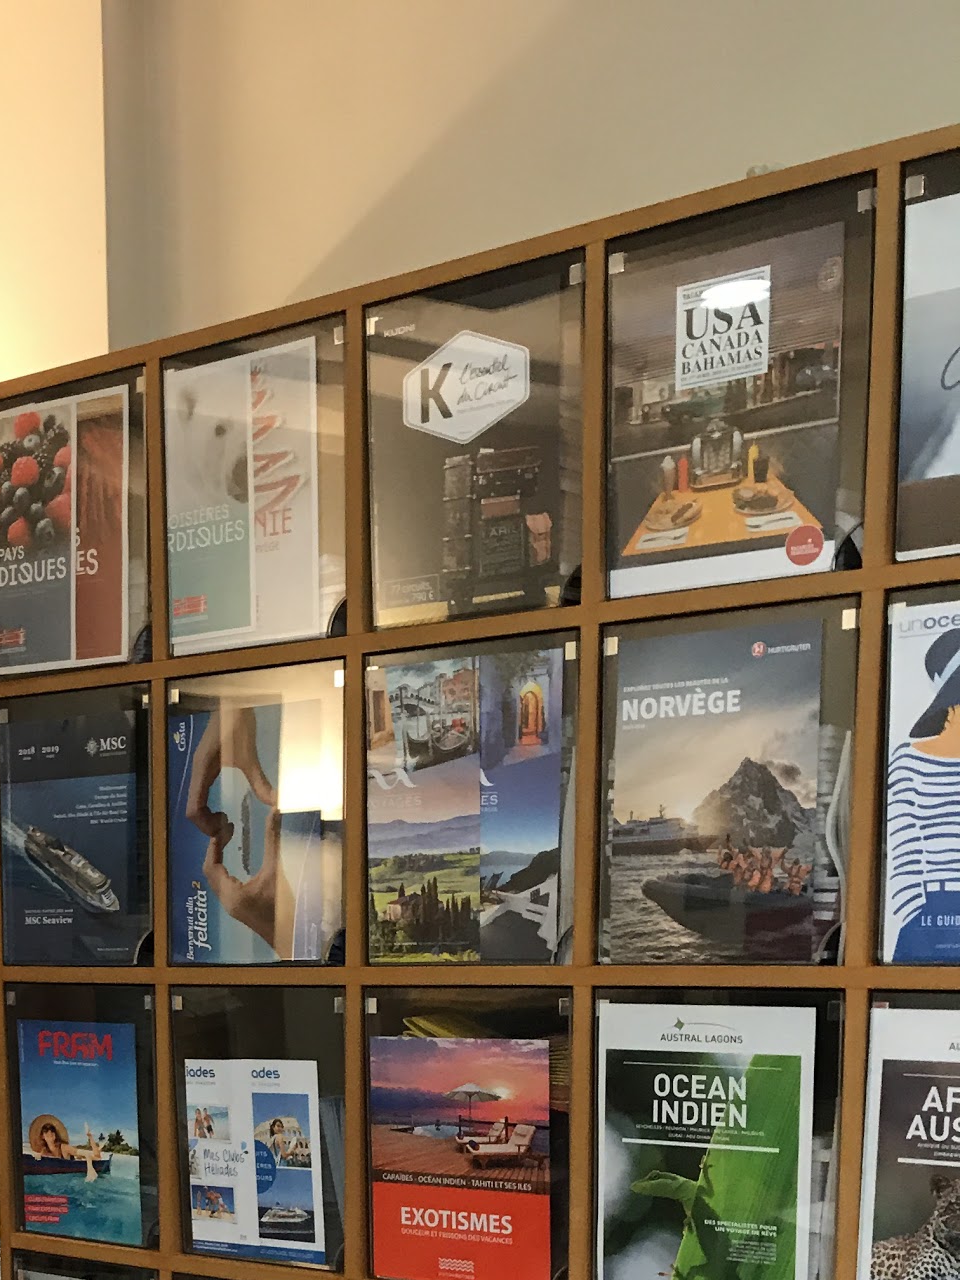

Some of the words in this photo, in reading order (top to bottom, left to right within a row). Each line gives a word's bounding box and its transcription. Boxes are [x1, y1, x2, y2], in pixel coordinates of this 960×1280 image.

[683, 301, 764, 340] USA
[681, 328, 763, 359] CANADA
[681, 346, 763, 375] BAHAMAS
[420, 362, 453, 424] K
[622, 687, 741, 721] NORVÈGE
[18, 746, 35, 756] 2018
[42, 745, 60, 755] 2019
[99, 736, 127, 751] MSC
[24, 916, 41, 925] MSC
[43, 915, 74, 925] Seaview
[921, 915, 932, 926] LE
[38, 1030, 114, 1061] FRAM
[660, 1033, 702, 1043] AUSTRAL
[705, 1034, 743, 1044] LAGONS
[251, 1067, 280, 1079] ades
[653, 1073, 747, 1100] OCEAN
[652, 1099, 747, 1128] INDIEN
[472, 1179, 493, 1188] TAHITI
[400, 1206, 513, 1235] EXOTISMES
